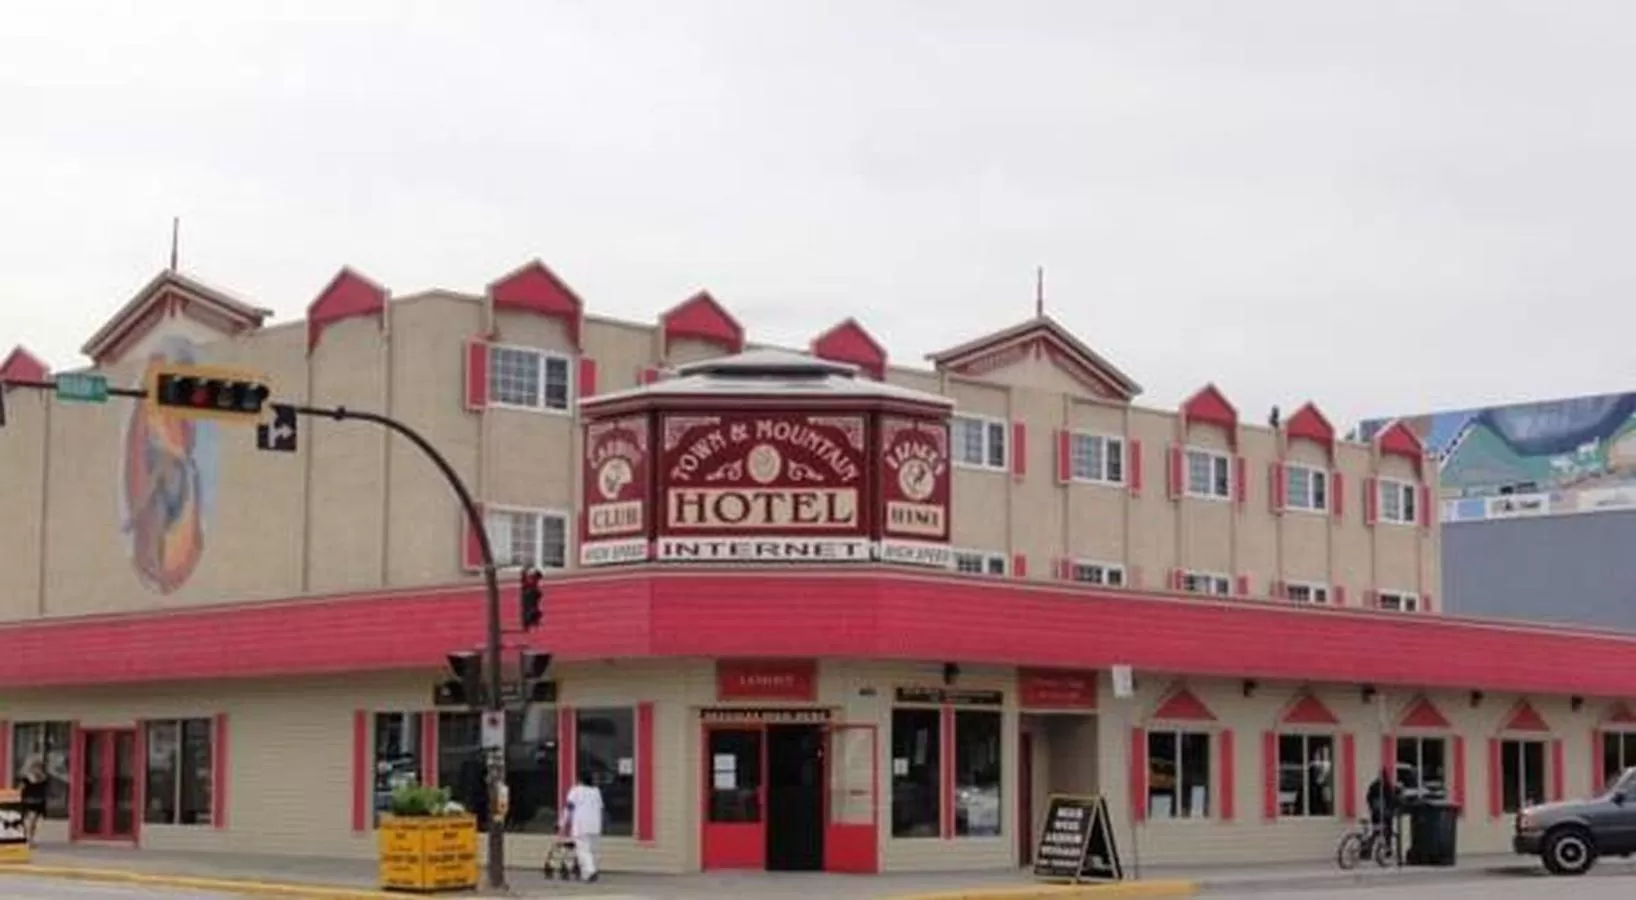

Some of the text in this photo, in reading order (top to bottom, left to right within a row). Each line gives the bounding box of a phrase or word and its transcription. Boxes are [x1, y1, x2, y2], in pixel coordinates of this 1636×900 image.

[671, 429, 727, 481] TOWN
[730, 423, 750, 442] &
[755, 419, 860, 482] MOUNTAIN
[674, 491, 853, 524] HOTEL
[663, 541, 863, 556] INTERNET
